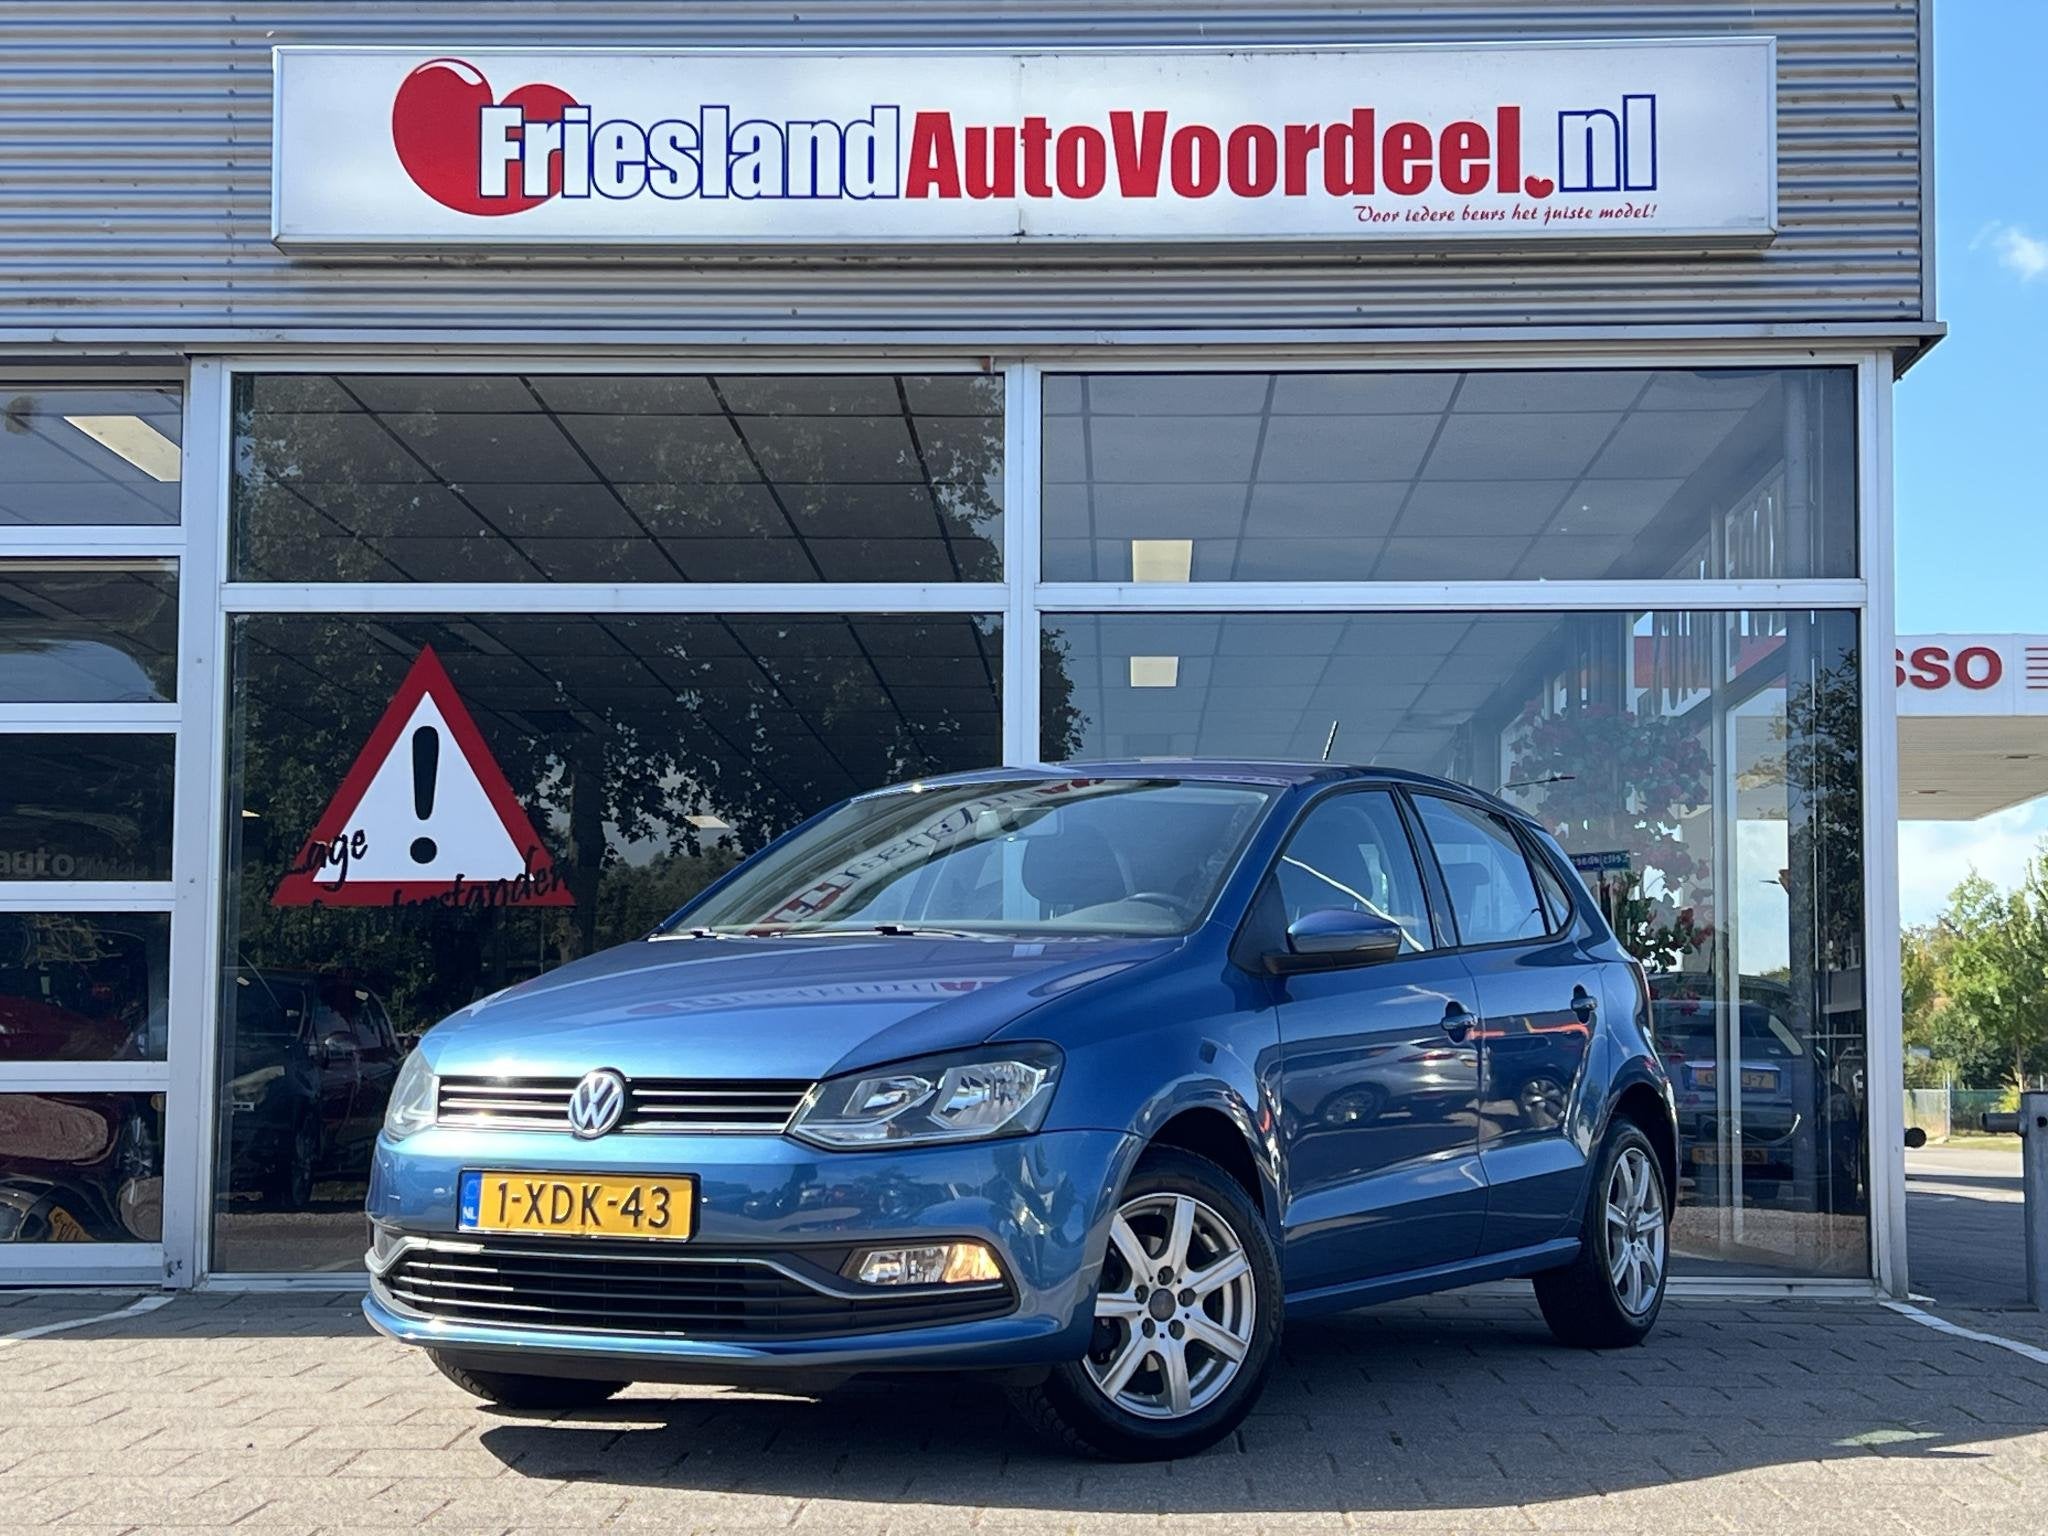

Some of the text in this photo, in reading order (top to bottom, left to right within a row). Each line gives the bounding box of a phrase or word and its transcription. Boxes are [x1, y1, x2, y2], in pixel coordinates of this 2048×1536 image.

[1353, 202, 1658, 226] Voor iedere beurs het juiste model!
[1895, 646, 2003, 691] SO
[462, 1205, 478, 1221] NL
[498, 1181, 671, 1229] 1-XDK-43
